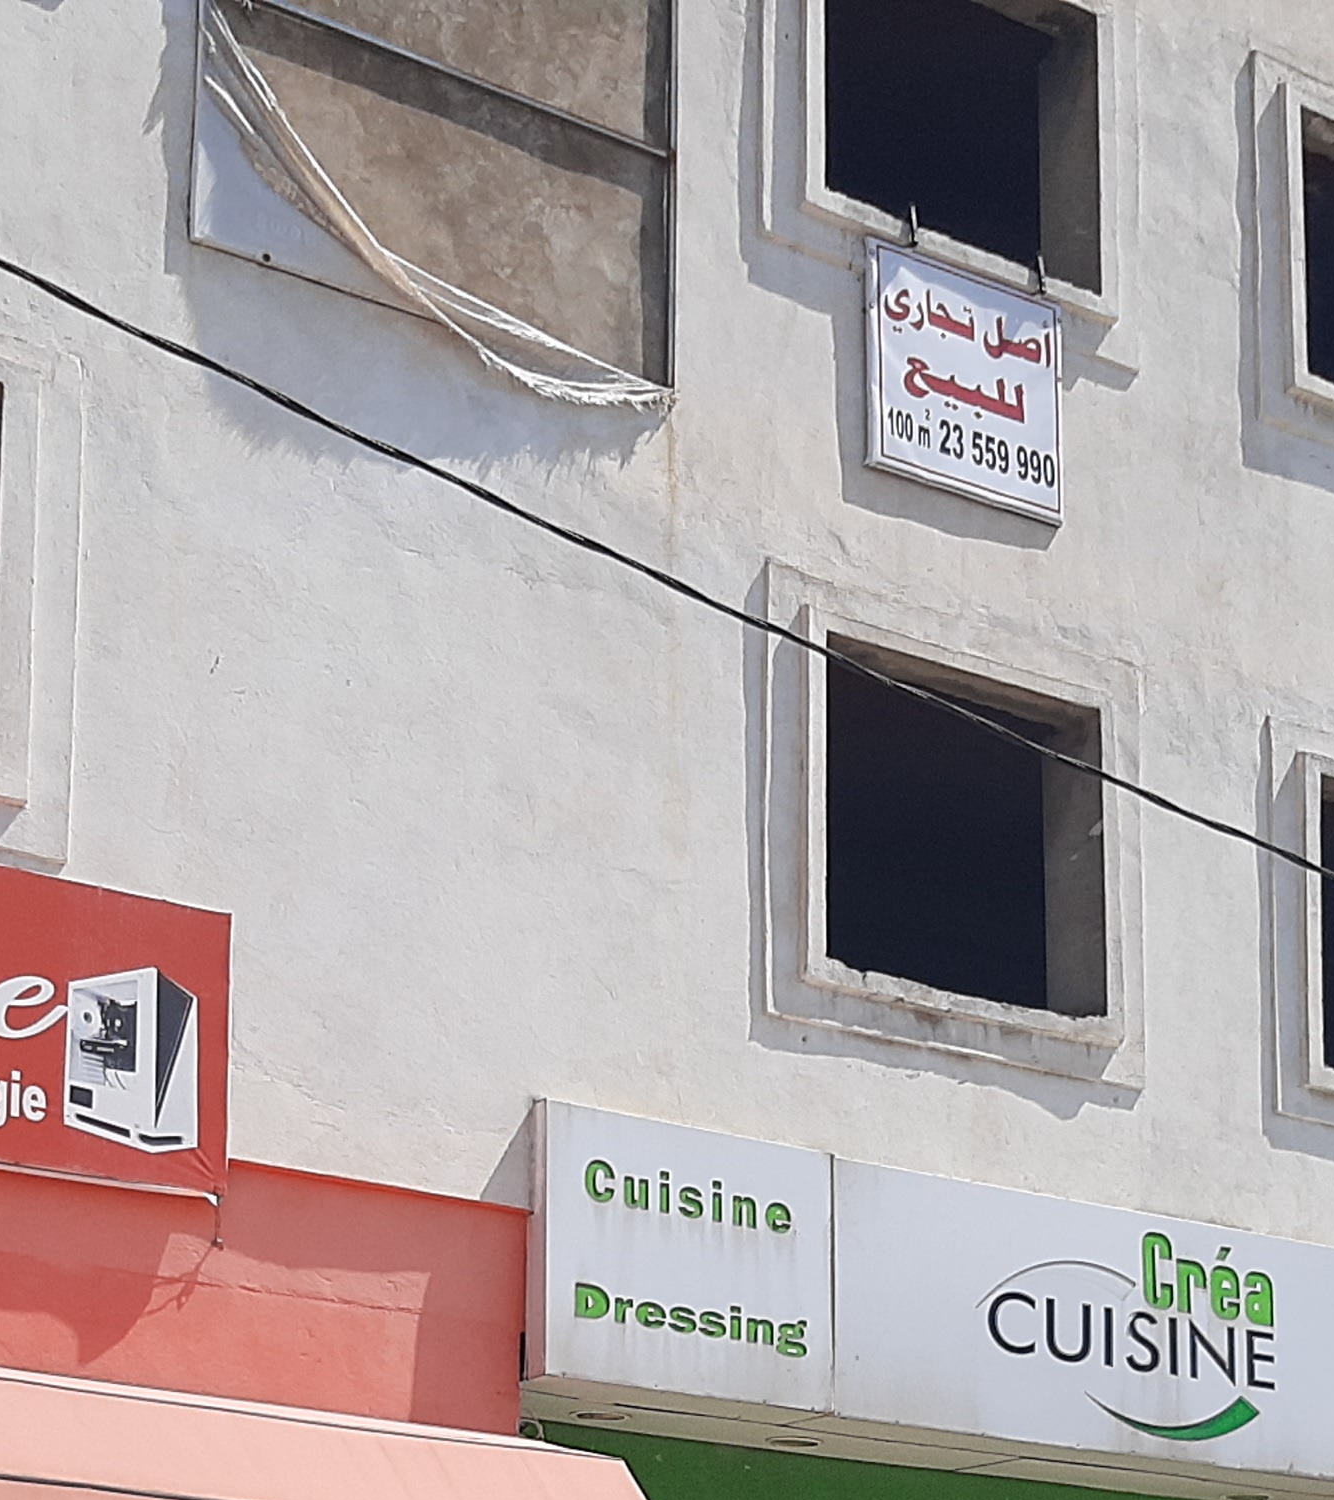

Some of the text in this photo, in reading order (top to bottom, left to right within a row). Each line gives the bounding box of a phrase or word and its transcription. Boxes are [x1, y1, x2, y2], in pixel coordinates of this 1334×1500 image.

[884, 289, 975, 342] تجاري
[904, 356, 1025, 424] للبيع
[887, 405, 914, 443] 100
[939, 419, 965, 461] 23
[971, 430, 1010, 475] 559
[1017, 446, 1056, 489] 990
[583, 1158, 794, 1236] Cuisine
[1141, 1231, 1276, 1327] Créa
[573, 1281, 810, 1359] Dressing
[986, 1290, 1279, 1392] CUISINE
